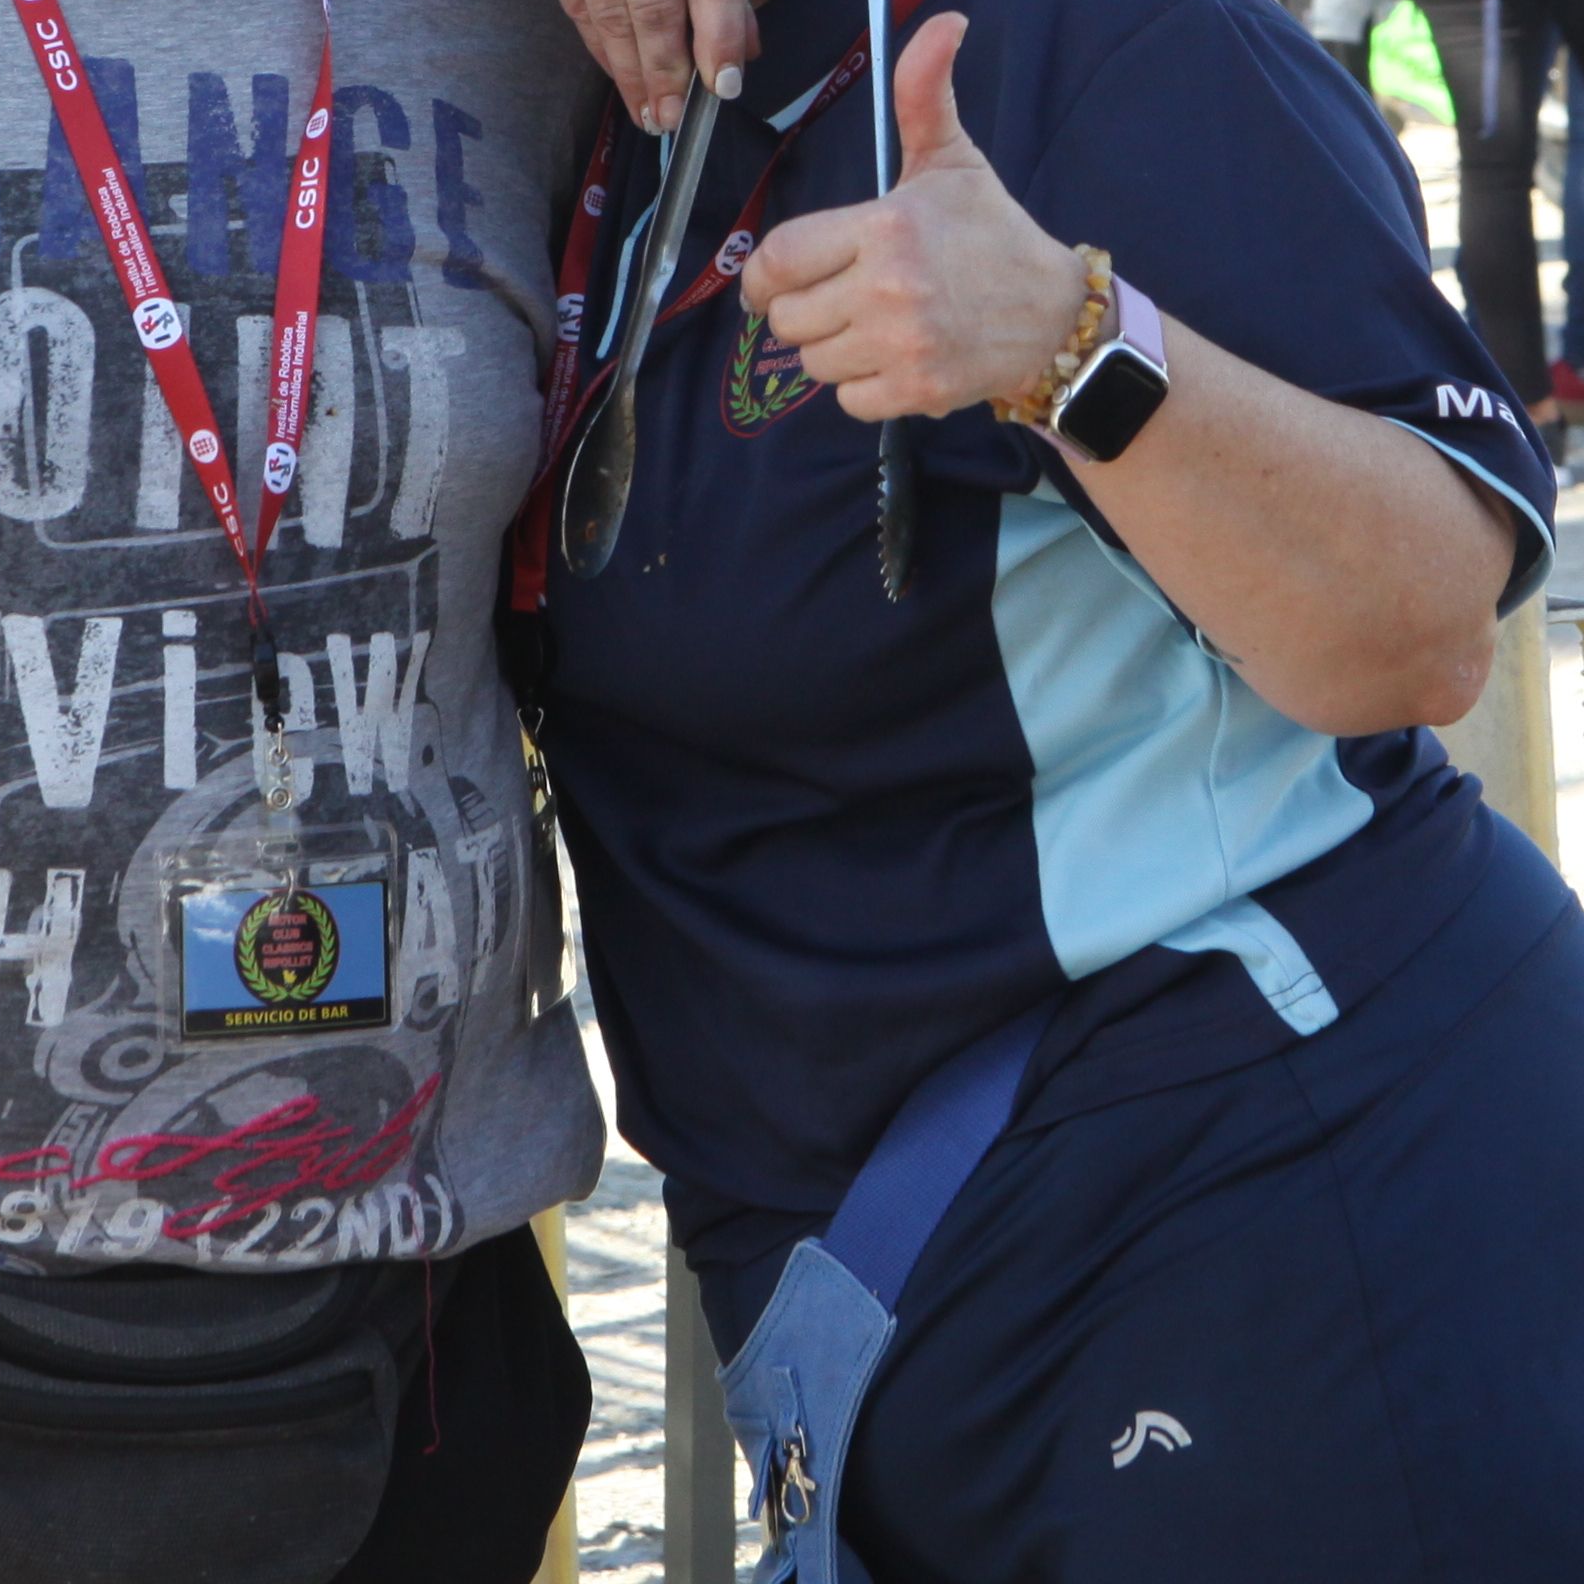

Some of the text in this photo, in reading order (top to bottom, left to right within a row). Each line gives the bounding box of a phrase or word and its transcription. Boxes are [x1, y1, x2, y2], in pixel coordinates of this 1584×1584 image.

[35, 18, 78, 91] CSIC
[295, 157, 320, 229] CSIC
[123, 257, 147, 299] Institut
[292, 311, 309, 365] Industrial
[213, 482, 245, 557] CSIC
[272, 928, 301, 939] CLUB
[225, 1005, 349, 1026] SERVICIO DE BAR
